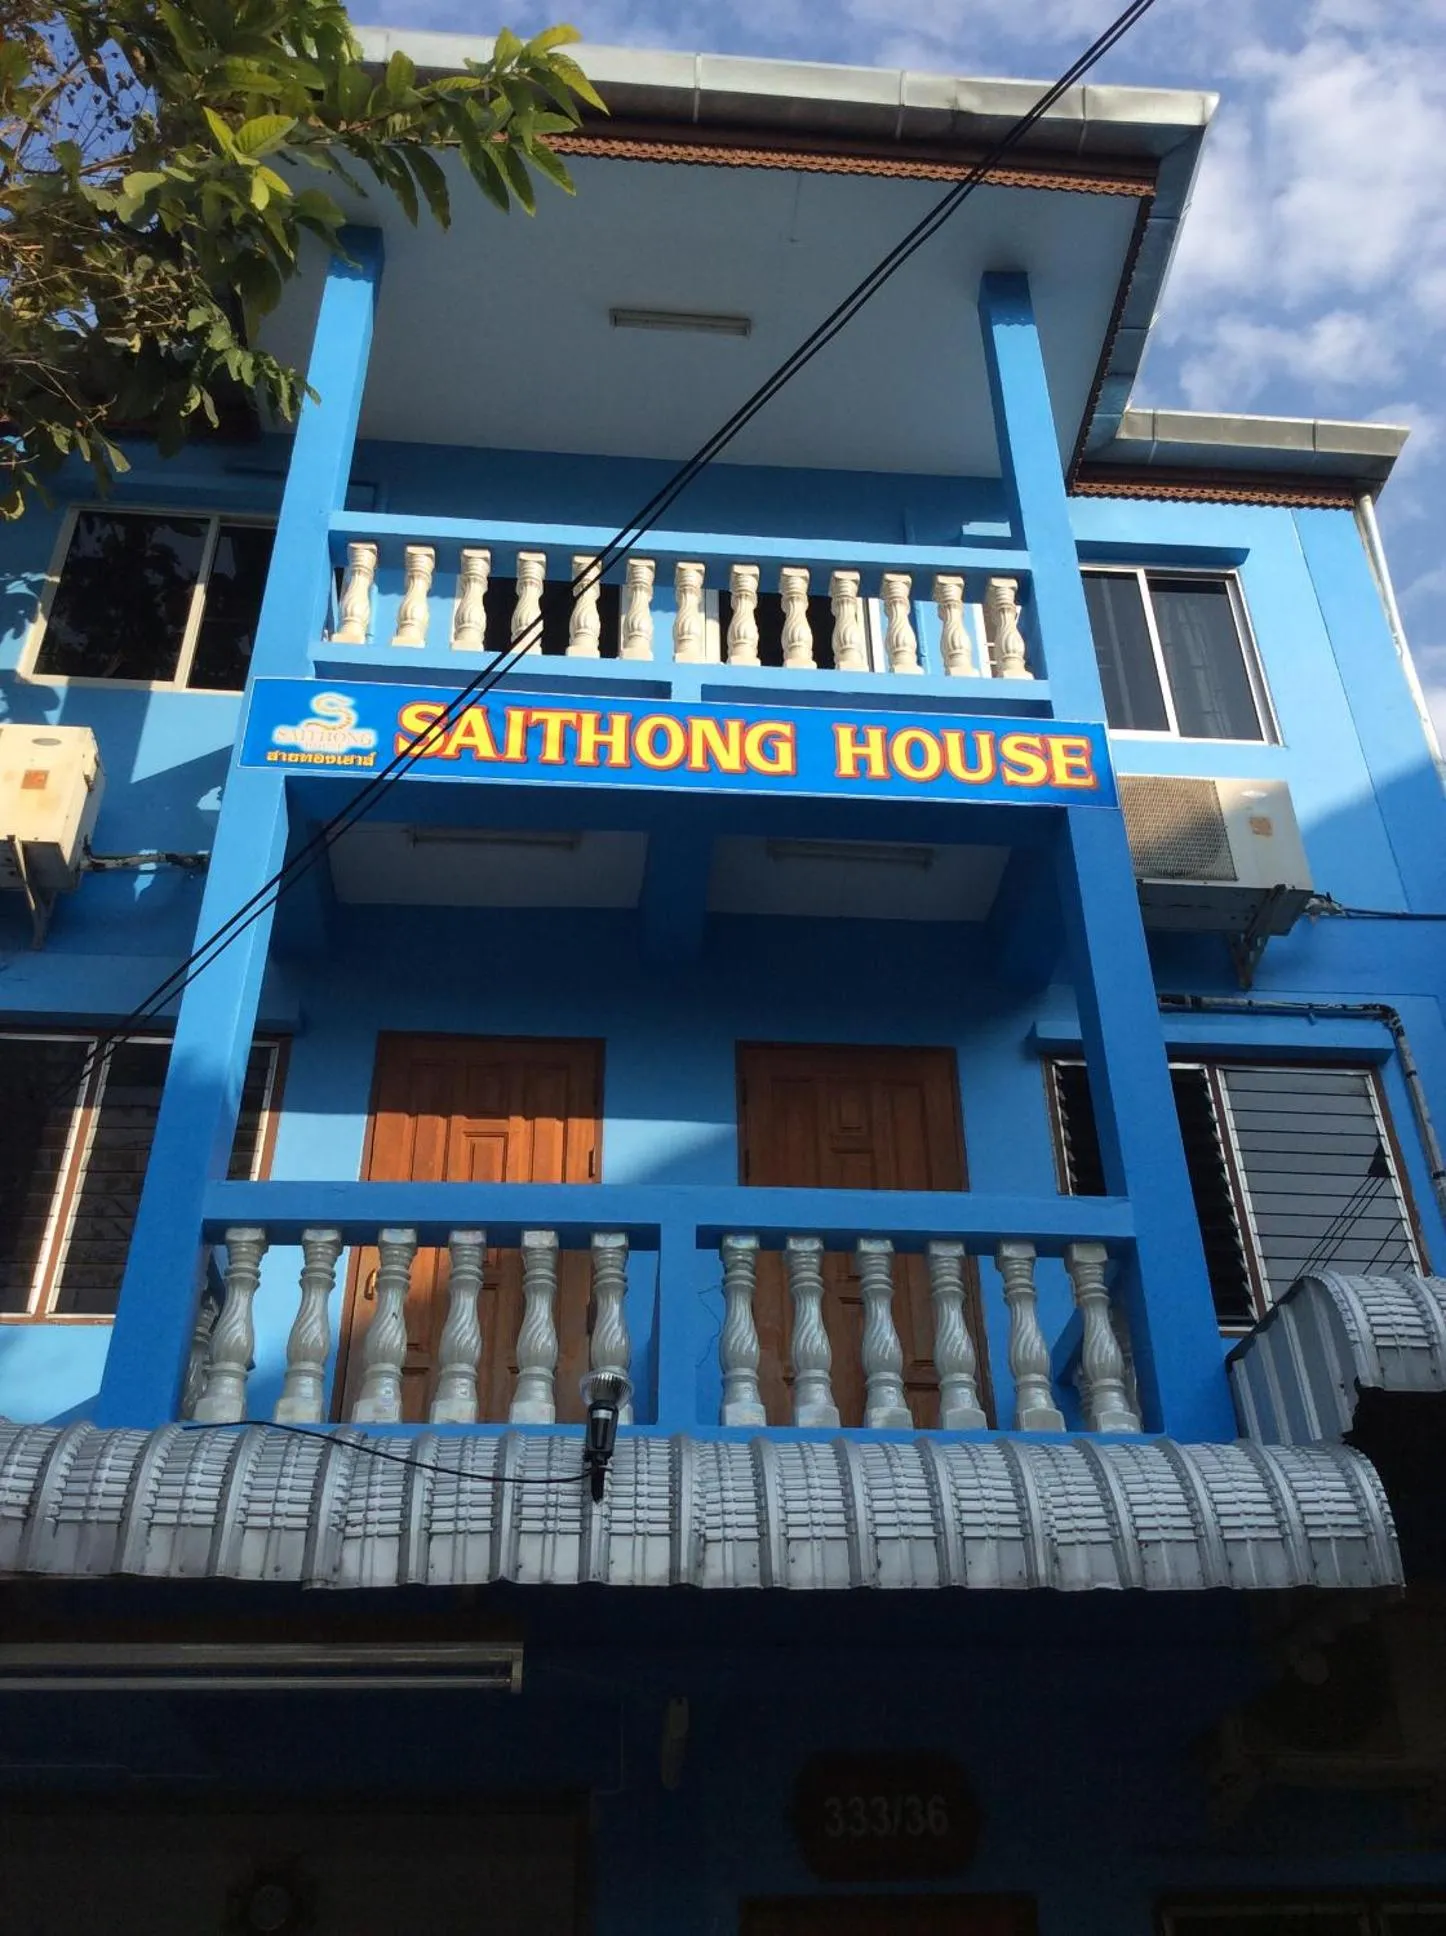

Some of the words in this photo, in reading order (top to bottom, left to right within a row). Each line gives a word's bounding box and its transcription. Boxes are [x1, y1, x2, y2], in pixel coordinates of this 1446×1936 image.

[396, 701, 796, 776] SAITHONG
[832, 723, 1097, 788] HOUSE
[824, 1794, 948, 1837] 333/36
